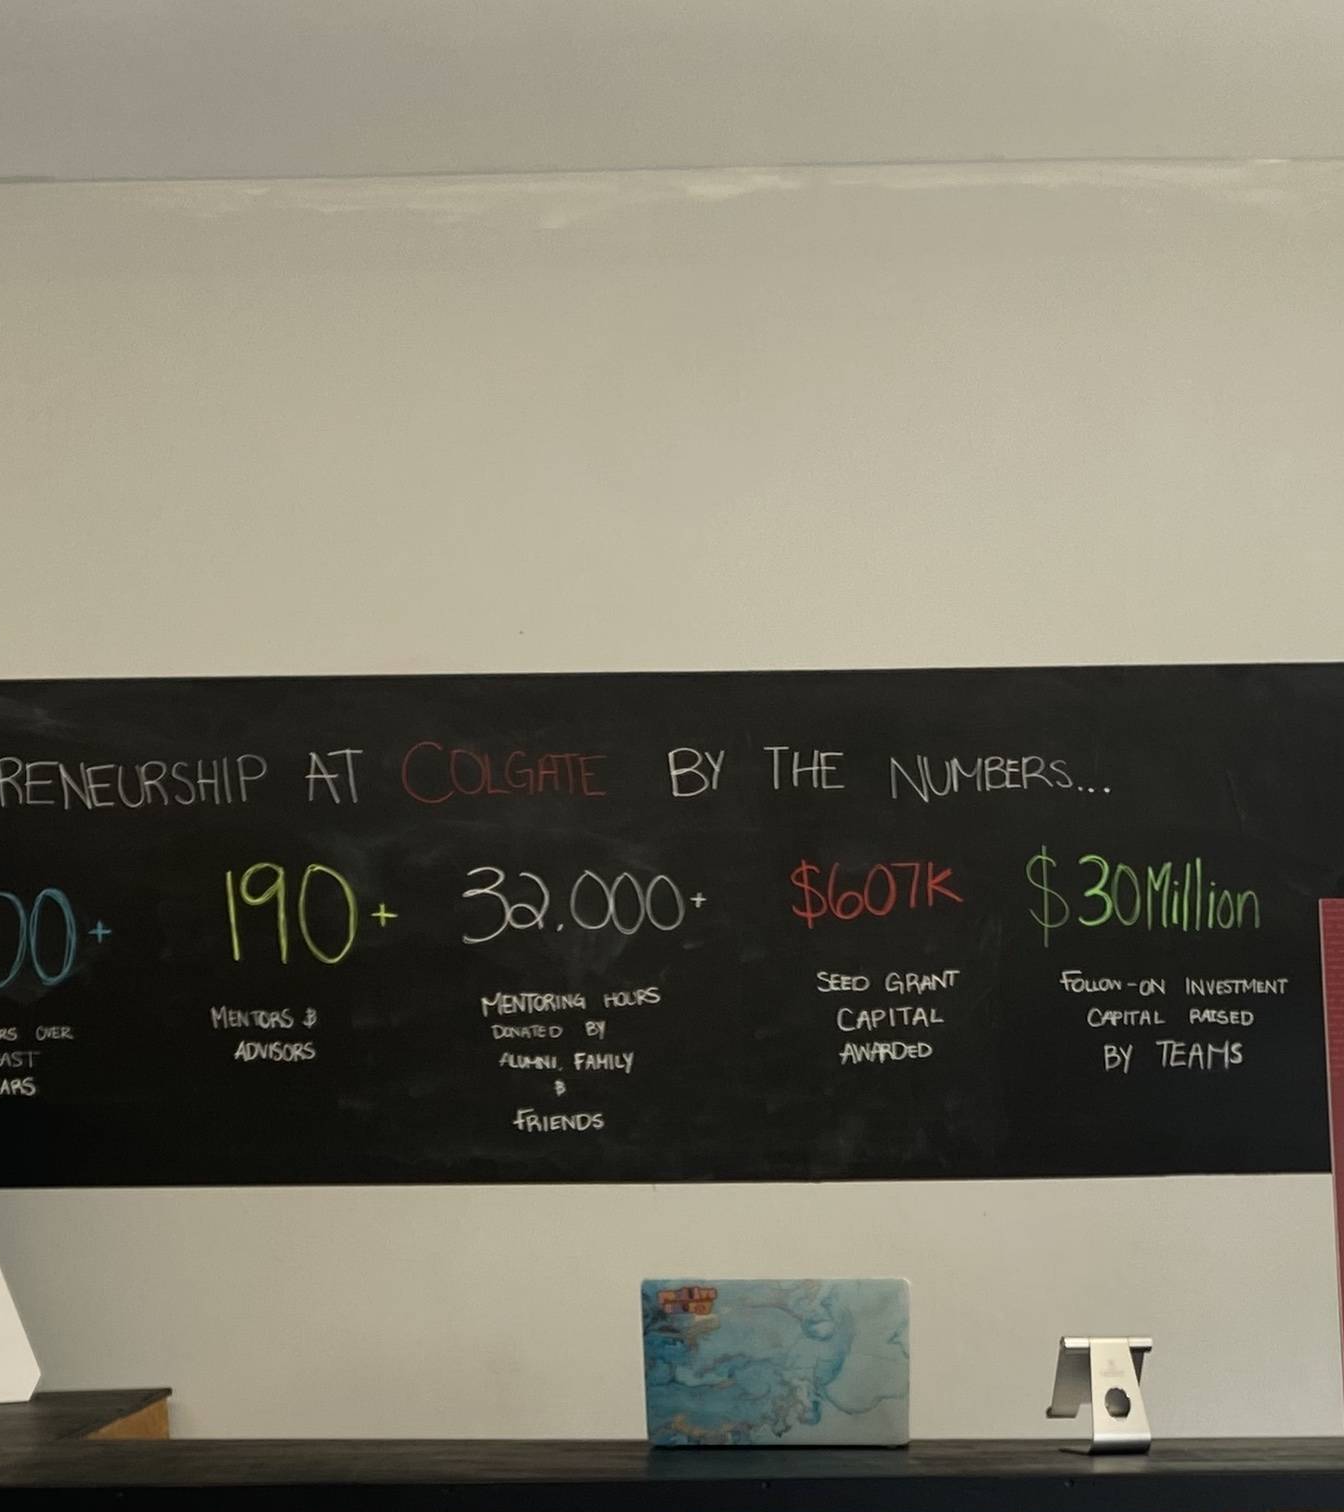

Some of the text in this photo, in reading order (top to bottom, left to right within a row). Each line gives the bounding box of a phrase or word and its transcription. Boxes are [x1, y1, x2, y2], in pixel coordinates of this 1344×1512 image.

[305, 748, 364, 804] AT
[402, 741, 607, 803] COLGATE
[666, 747, 725, 797] BY
[764, 746, 845, 791] THE
[891, 754, 1111, 802] NUMBERS...
[790, 858, 964, 929] $607K
[816, 969, 960, 993] SEED GRANT
[1185, 977, 1288, 995] INVESTMENT
[481, 986, 661, 1017] MENTORING HOURS
[210, 1005, 294, 1032] MENTORS
[836, 1008, 945, 1031] CAPITAL
[1087, 1008, 1254, 1026] CAPITAL RAISED
[35, 1025, 74, 1041] OVER
[492, 1020, 606, 1040] DONATED BY
[234, 1040, 316, 1062] ADVISORS
[839, 1041, 933, 1063] AWARDED
[1104, 1040, 1243, 1073] BY TEAMS
[574, 1052, 634, 1074] FAMILY
[513, 1108, 604, 1132] FRIENDS
